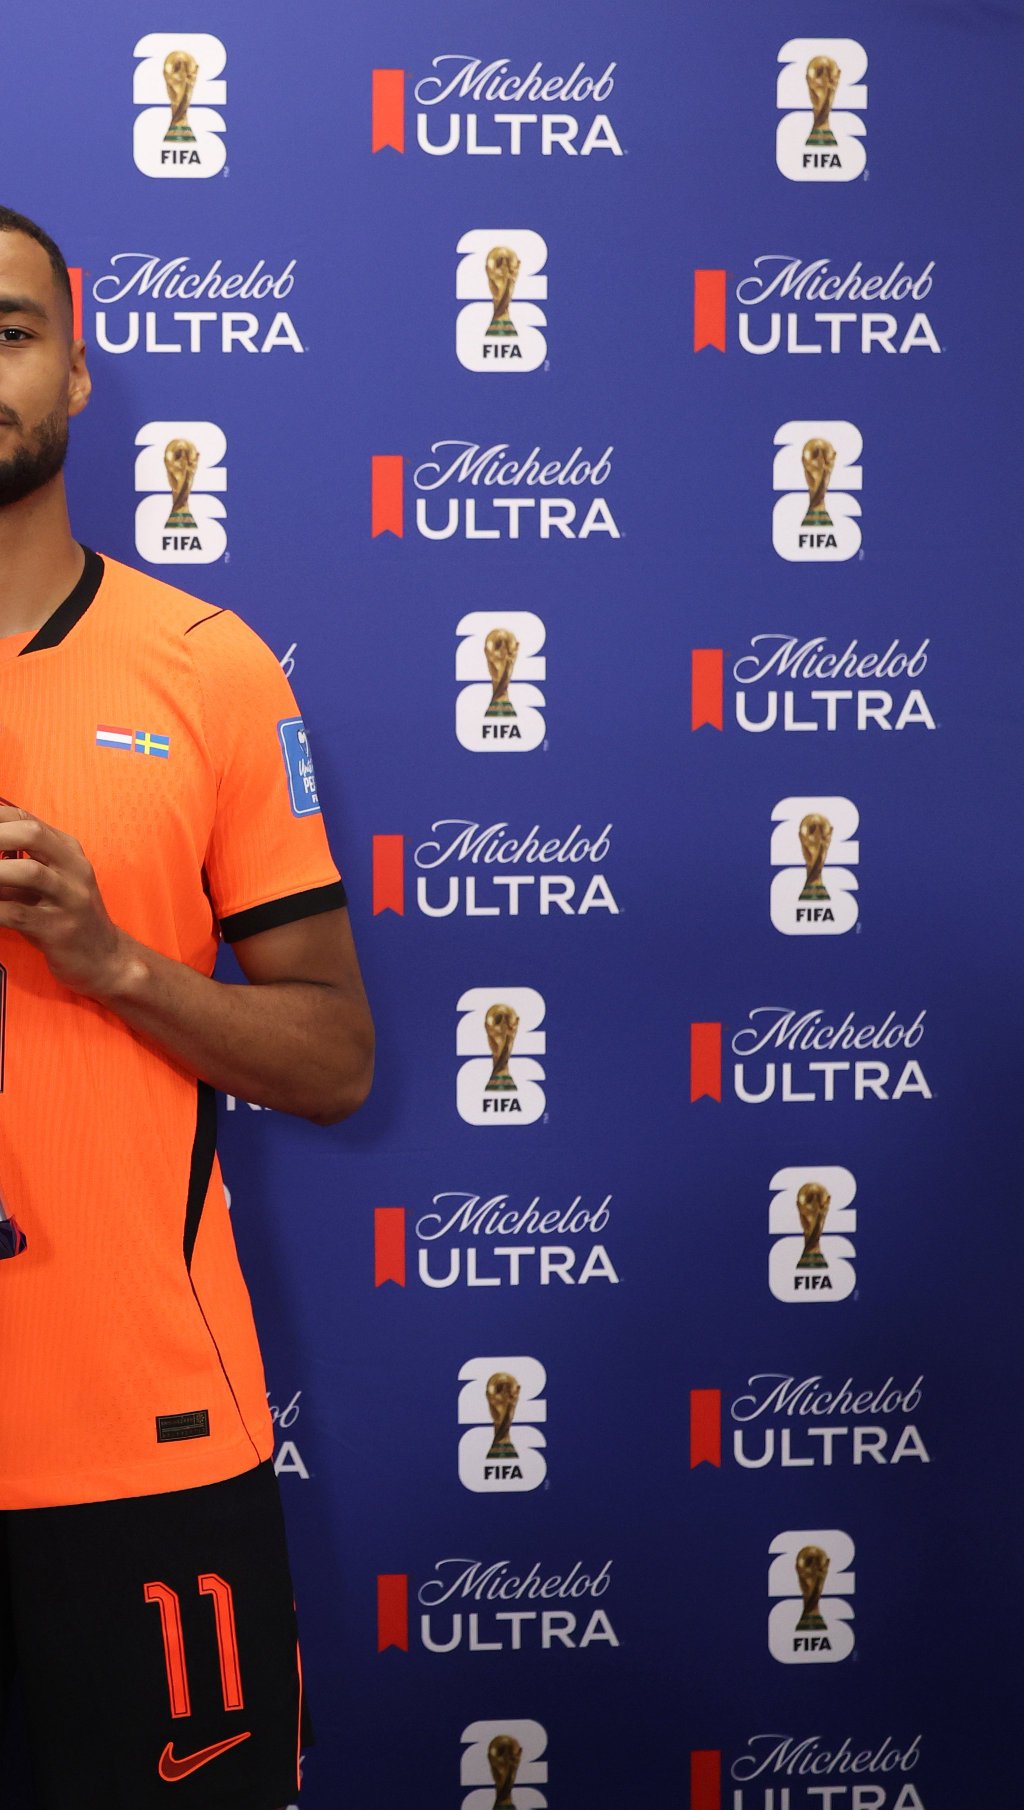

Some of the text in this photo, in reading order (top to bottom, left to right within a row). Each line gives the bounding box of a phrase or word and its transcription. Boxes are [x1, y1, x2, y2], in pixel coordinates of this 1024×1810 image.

[414, 54, 617, 106] Michelob
[416, 112, 624, 156] ULTRA
[161, 150, 201, 165] FIFA
[802, 153, 842, 168] FIFA
[92, 252, 297, 304] Michelob
[735, 254, 936, 306] Michelob
[95, 311, 305, 354] ULTRA
[482, 344, 522, 359] FIFA
[738, 312, 942, 355] ULTRA
[413, 439, 614, 491] Michelob
[416, 497, 621, 541] ULTRA
[798, 534, 838, 548] FIFA
[162, 536, 202, 551] FIFA
[732, 633, 931, 684] Michelob
[482, 724, 522, 739] FIFA
[735, 689, 937, 733] ULTRA
[413, 818, 613, 869] Michelob
[416, 874, 620, 918] ULTRA
[796, 907, 835, 922] FIFA
[731, 1006, 927, 1056] Michelob
[734, 1059, 933, 1104] ULTRA
[482, 1098, 522, 1113] FIFA
[415, 1191, 613, 1241] Michelob
[418, 1244, 620, 1289] ULTRA
[794, 1275, 833, 1291] FIFA
[730, 1373, 924, 1422] Michelob
[733, 1424, 931, 1469] ULTRA
[484, 1465, 524, 1480] FIFA
[417, 1558, 613, 1607] Michelob
[143, 1573, 244, 1719] 11
[420, 1609, 620, 1653] ULTRA
[793, 1636, 832, 1652] FIFA
[730, 1734, 922, 1782] Michelob
